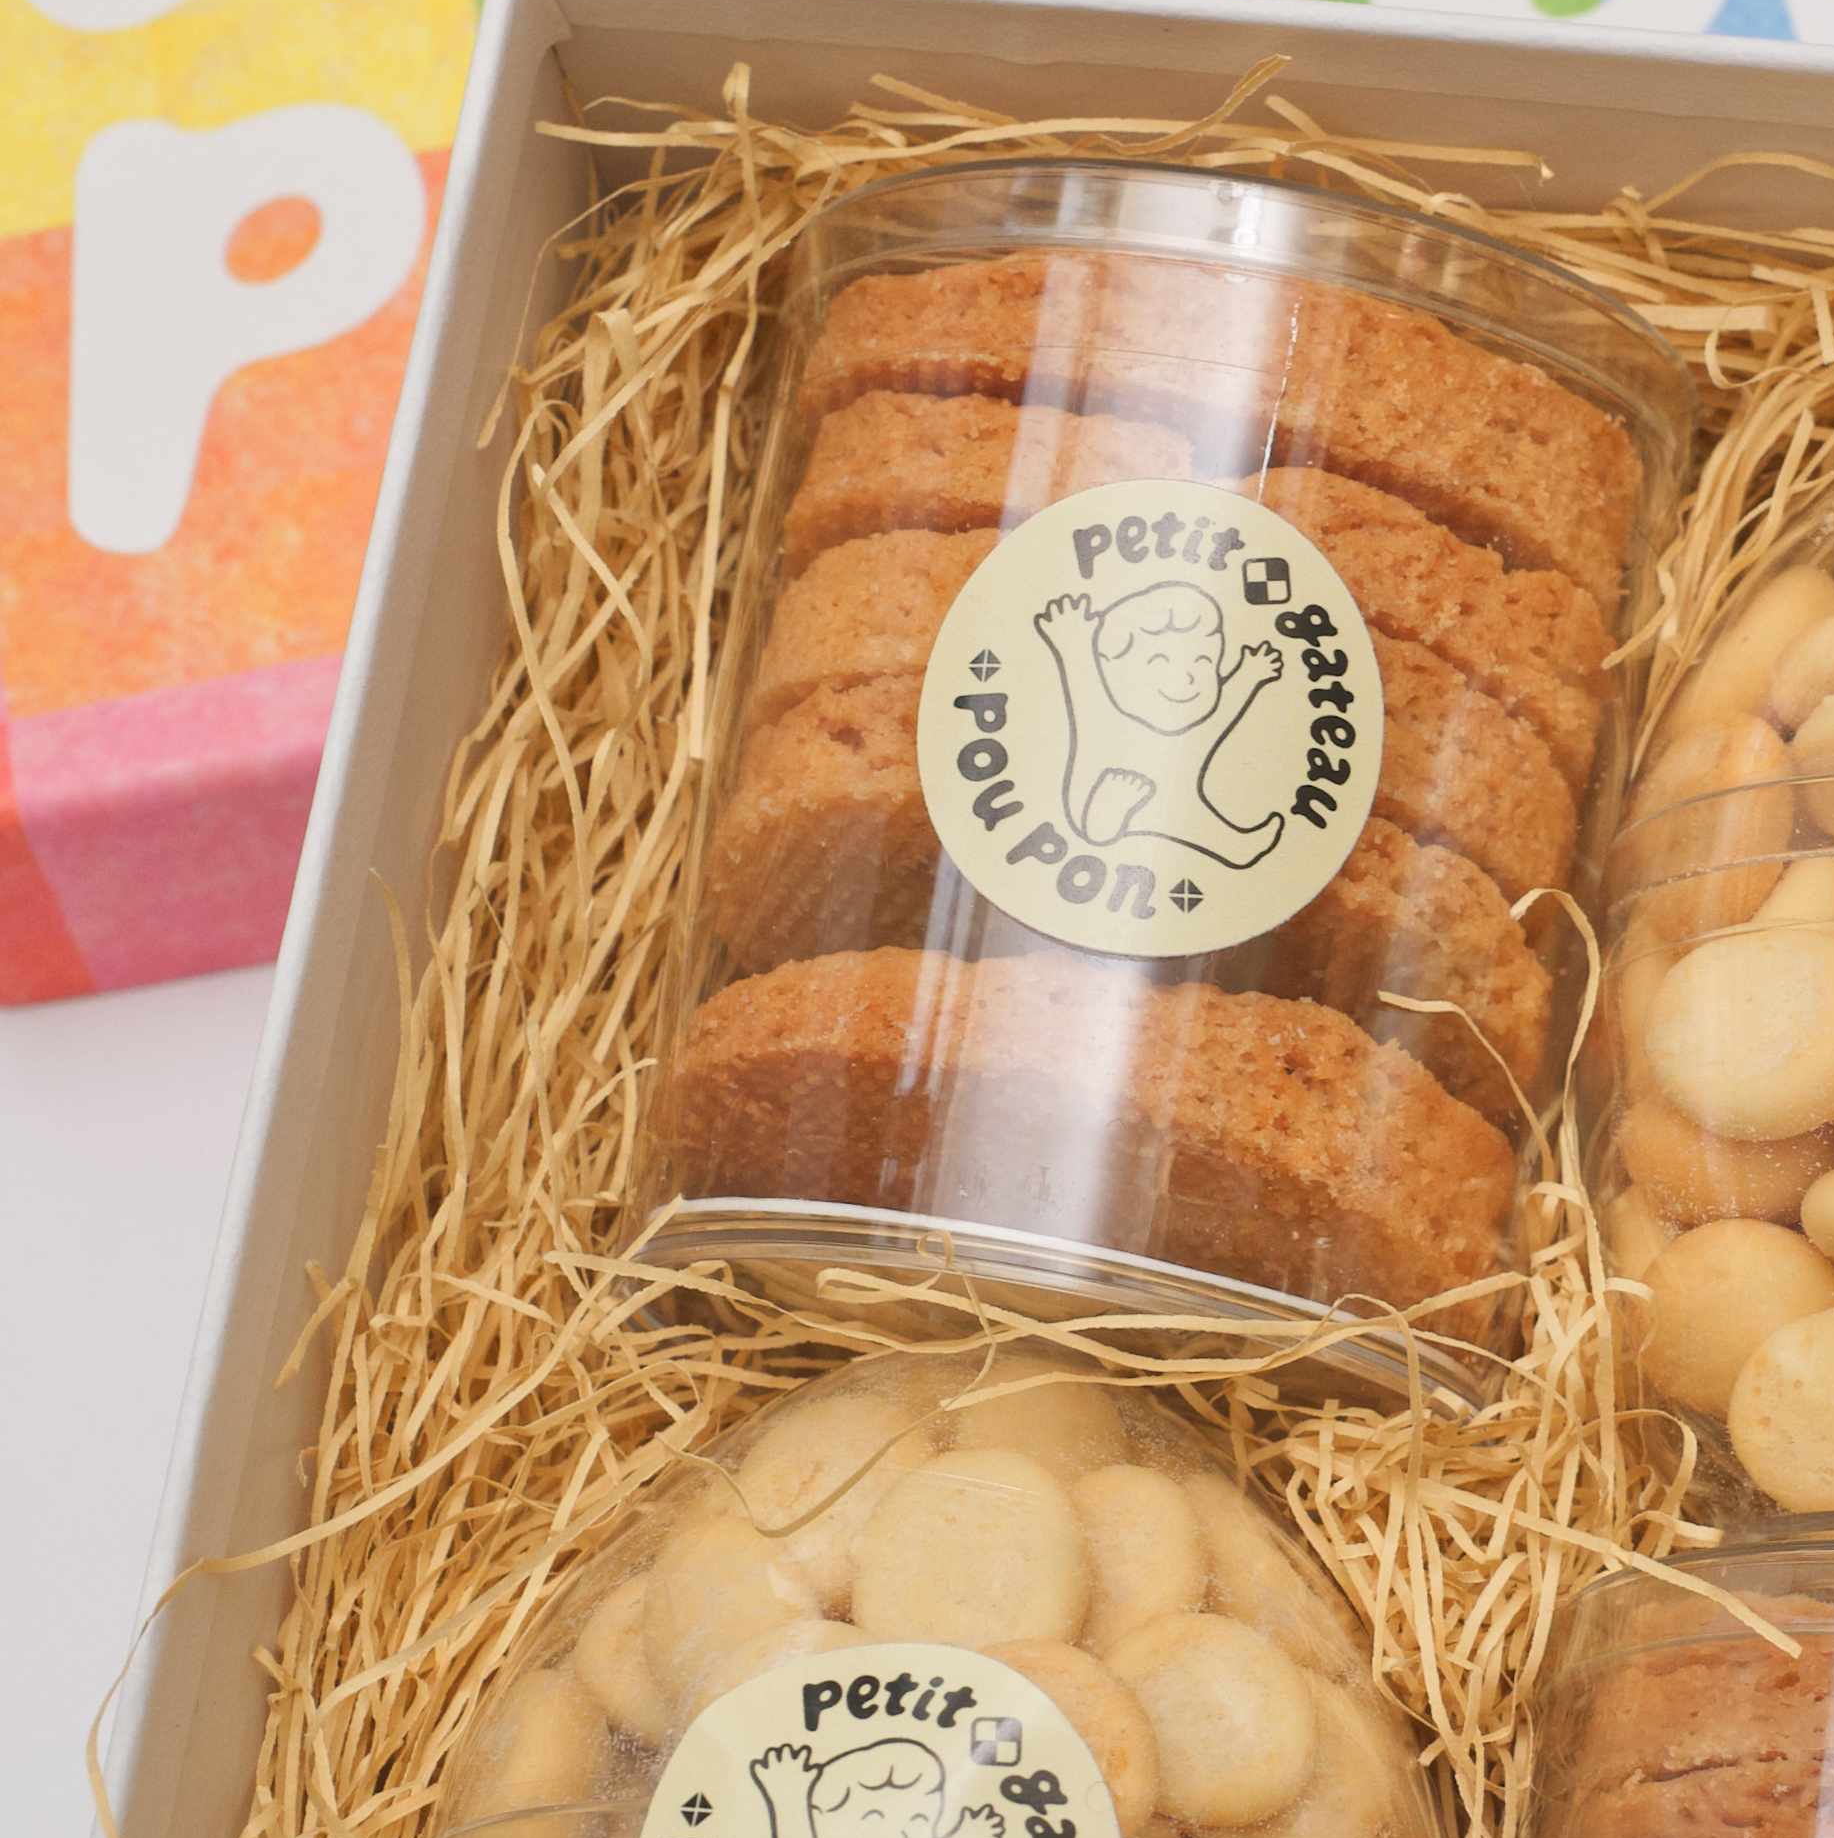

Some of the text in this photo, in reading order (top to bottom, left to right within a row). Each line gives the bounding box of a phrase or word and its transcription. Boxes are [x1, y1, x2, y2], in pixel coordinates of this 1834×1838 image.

[1072, 512, 1356, 829] petit gateau
[954, 693, 1157, 920] pou pon
[802, 1672, 977, 1731] petit
